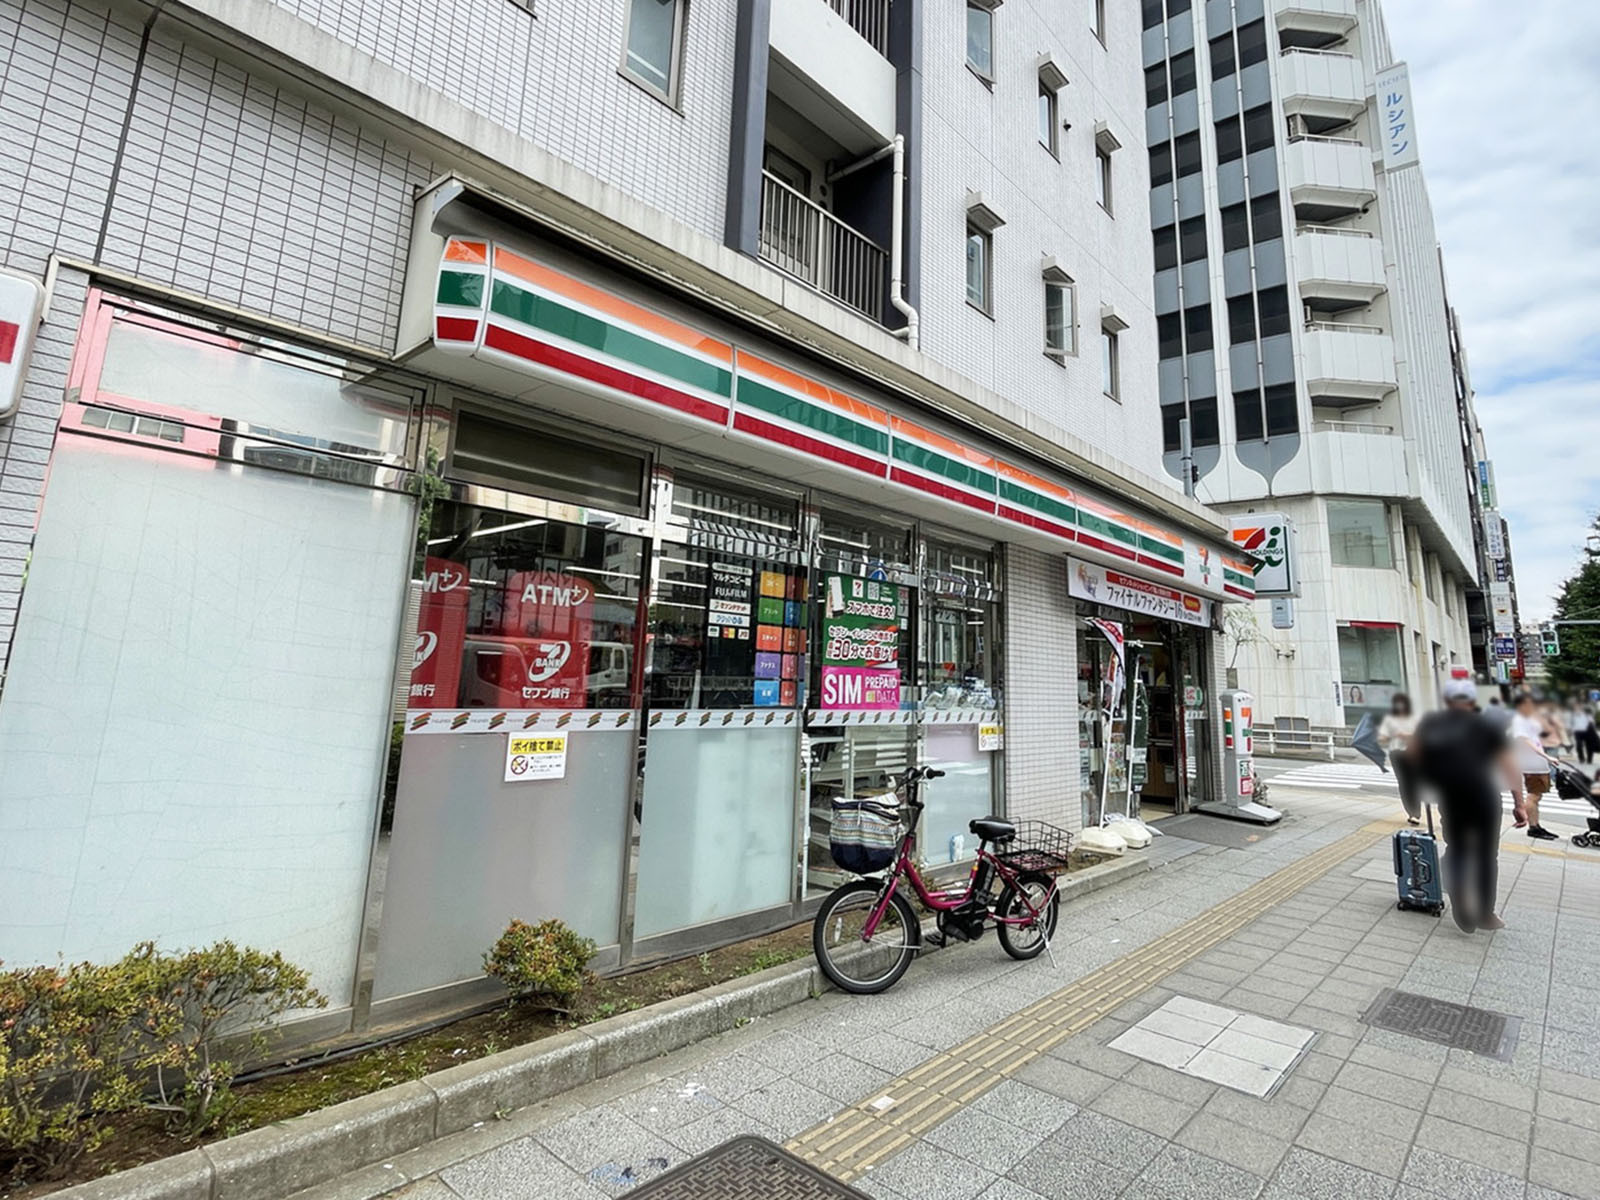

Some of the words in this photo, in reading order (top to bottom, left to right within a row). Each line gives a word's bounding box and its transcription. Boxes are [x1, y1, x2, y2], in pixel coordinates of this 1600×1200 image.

[1386, 92, 1409, 156] ルシアン
[1250, 547, 1285, 556] HOLDINGS
[520, 583, 571, 608] ATM
[714, 586, 748, 599] FUJIFILM
[1106, 585, 1183, 619] ファイナルファンタジー16
[823, 673, 862, 705] SIM
[864, 676, 897, 689] PREPAID
[521, 686, 570, 699] セブン銀行
[876, 690, 897, 704] DATA
